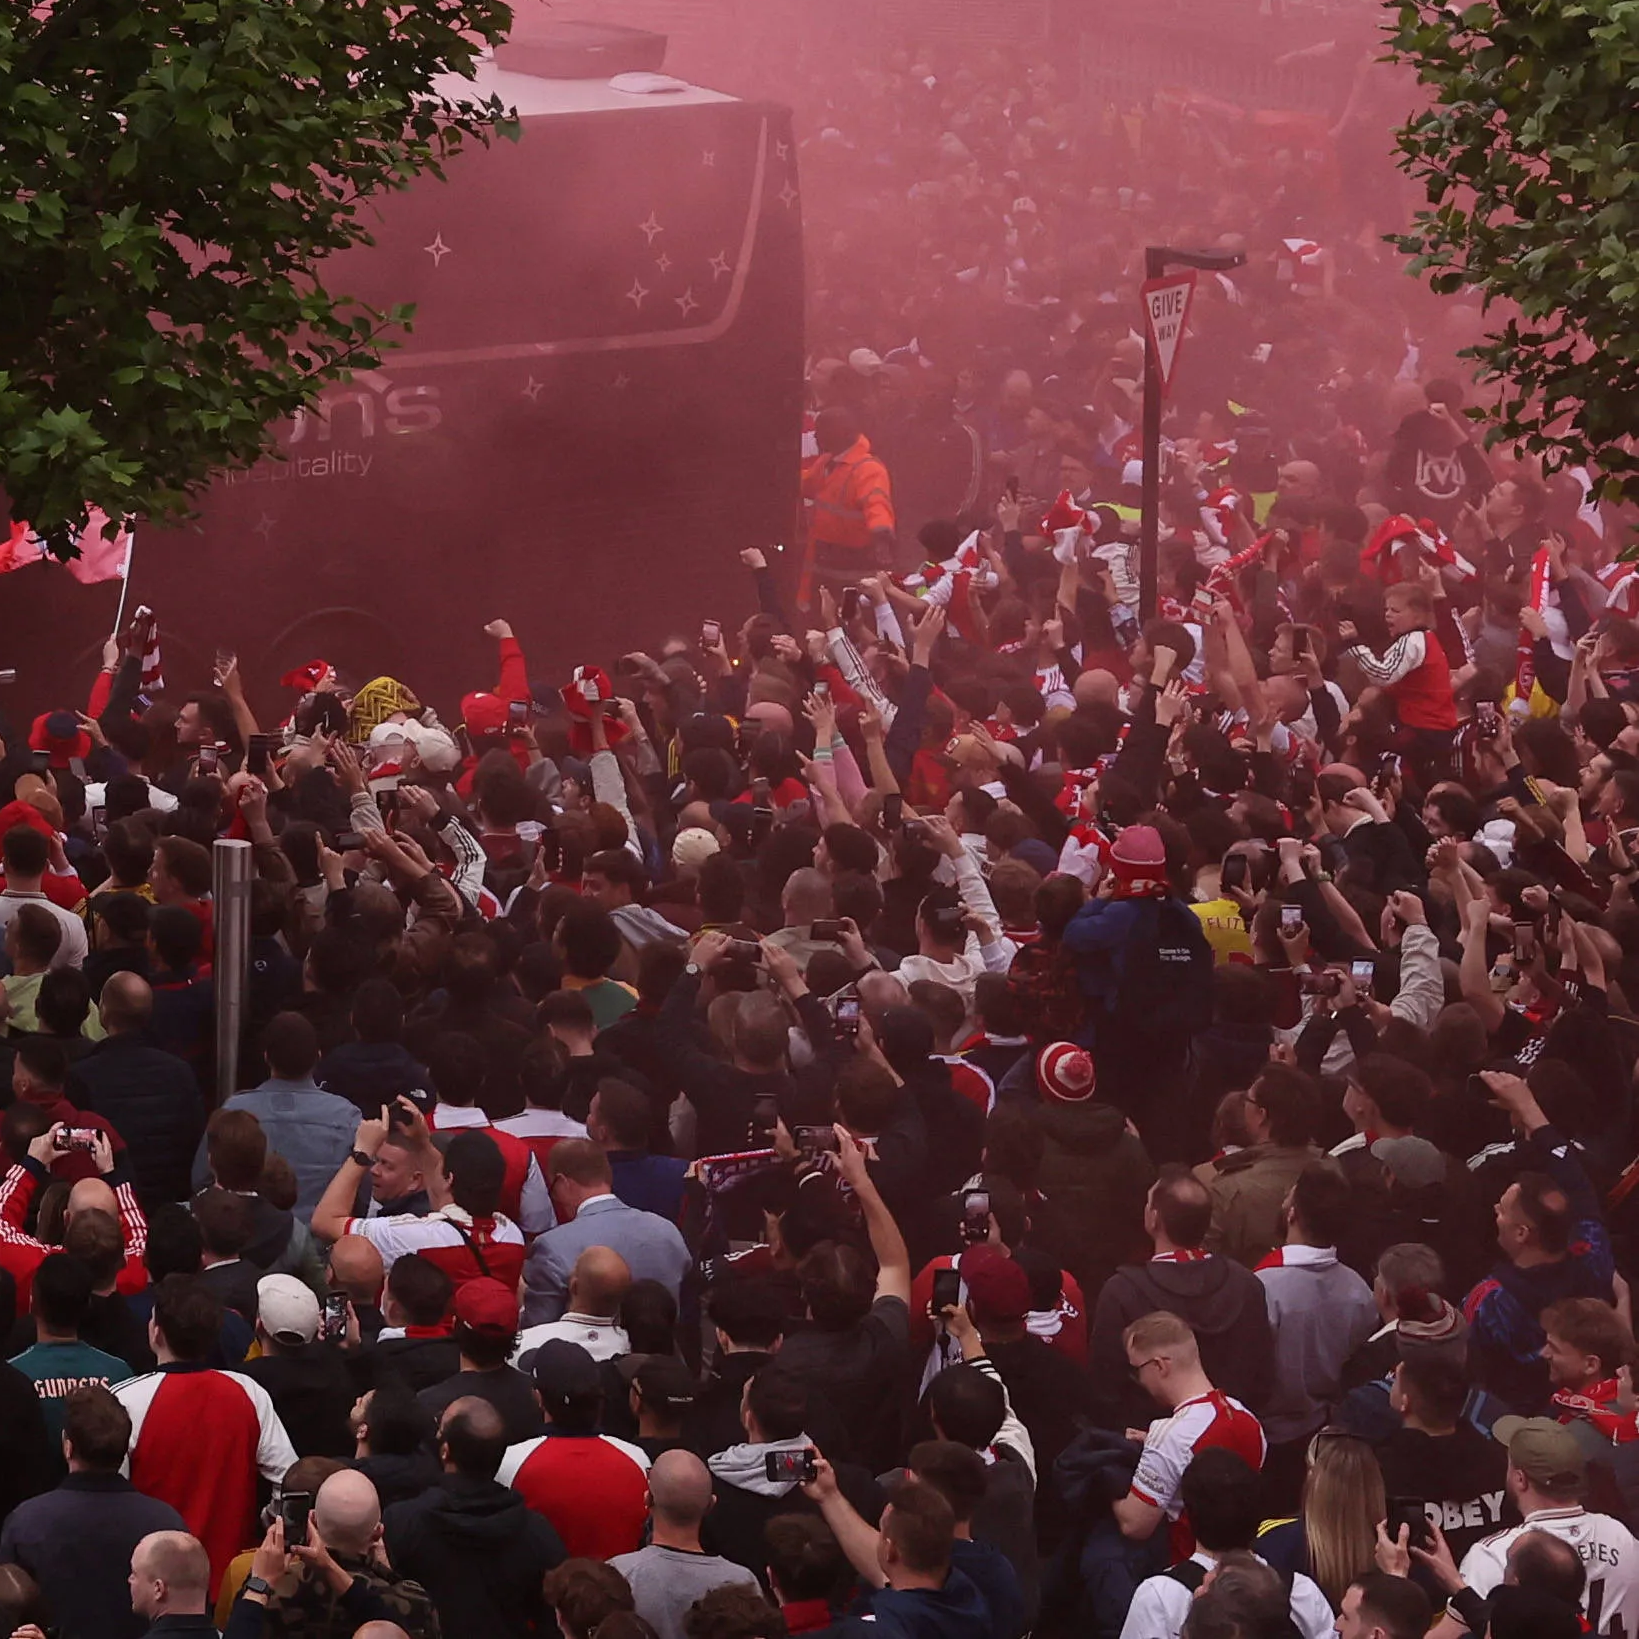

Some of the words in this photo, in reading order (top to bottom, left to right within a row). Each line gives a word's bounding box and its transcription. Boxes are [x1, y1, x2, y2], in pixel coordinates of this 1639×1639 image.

[1152, 290, 1182, 320] GIVE
[1158, 323, 1177, 342] WAY
[1424, 1490, 1505, 1531] OBEY
